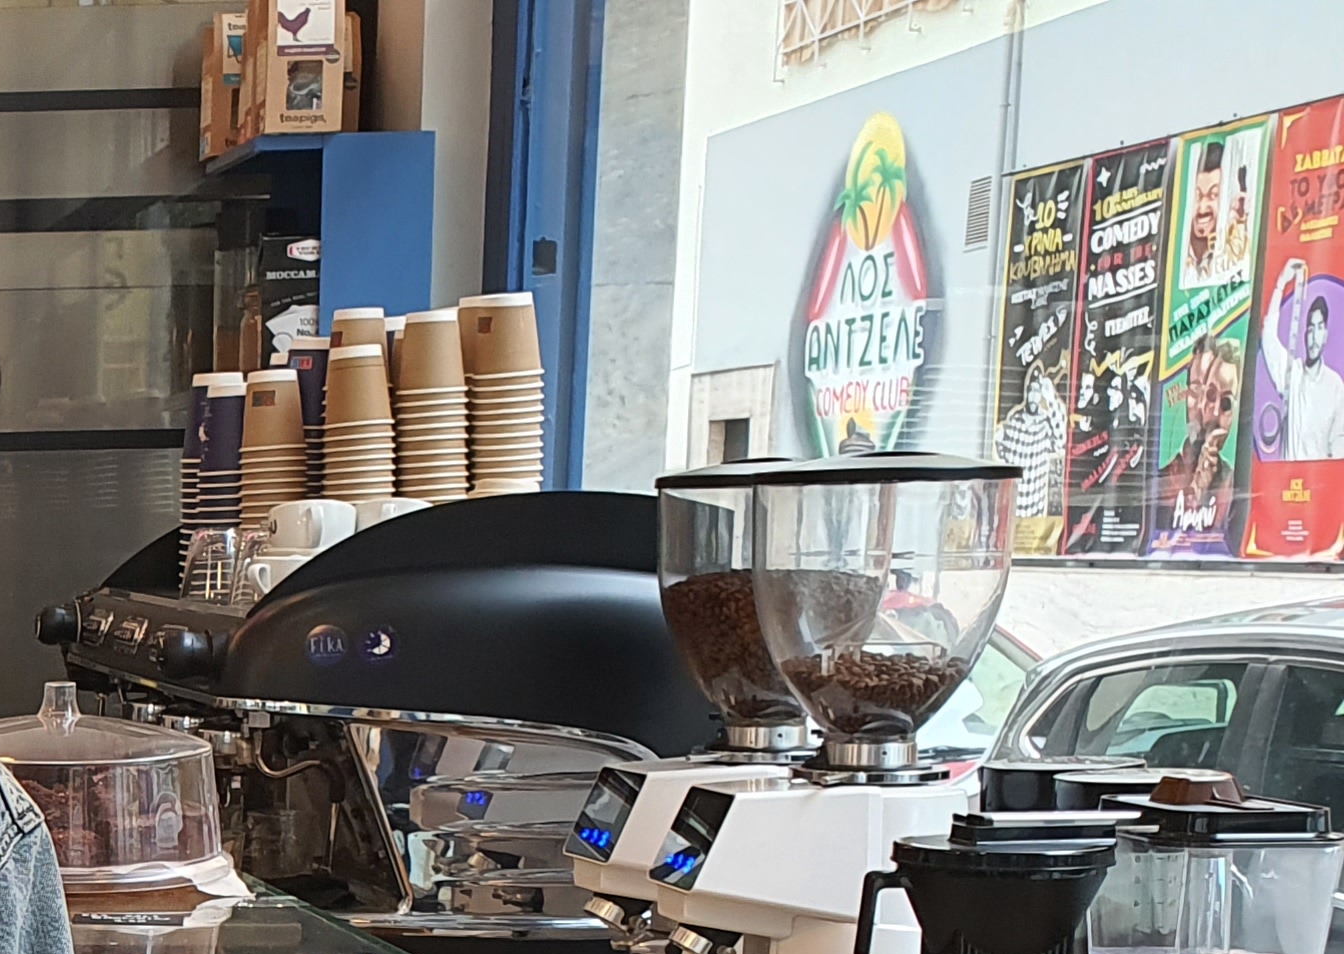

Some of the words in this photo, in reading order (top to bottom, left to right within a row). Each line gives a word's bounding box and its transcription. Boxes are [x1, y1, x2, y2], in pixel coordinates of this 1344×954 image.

[1034, 200, 1056, 230] 10
[1090, 210, 1162, 254] COMEDY
[265, 269, 317, 280] MOCCAM
[840, 251, 894, 305] ΛΟΣ
[1087, 259, 1156, 301] MASSES
[815, 379, 870, 417] COMEDY
[872, 376, 911, 412] CLUB
